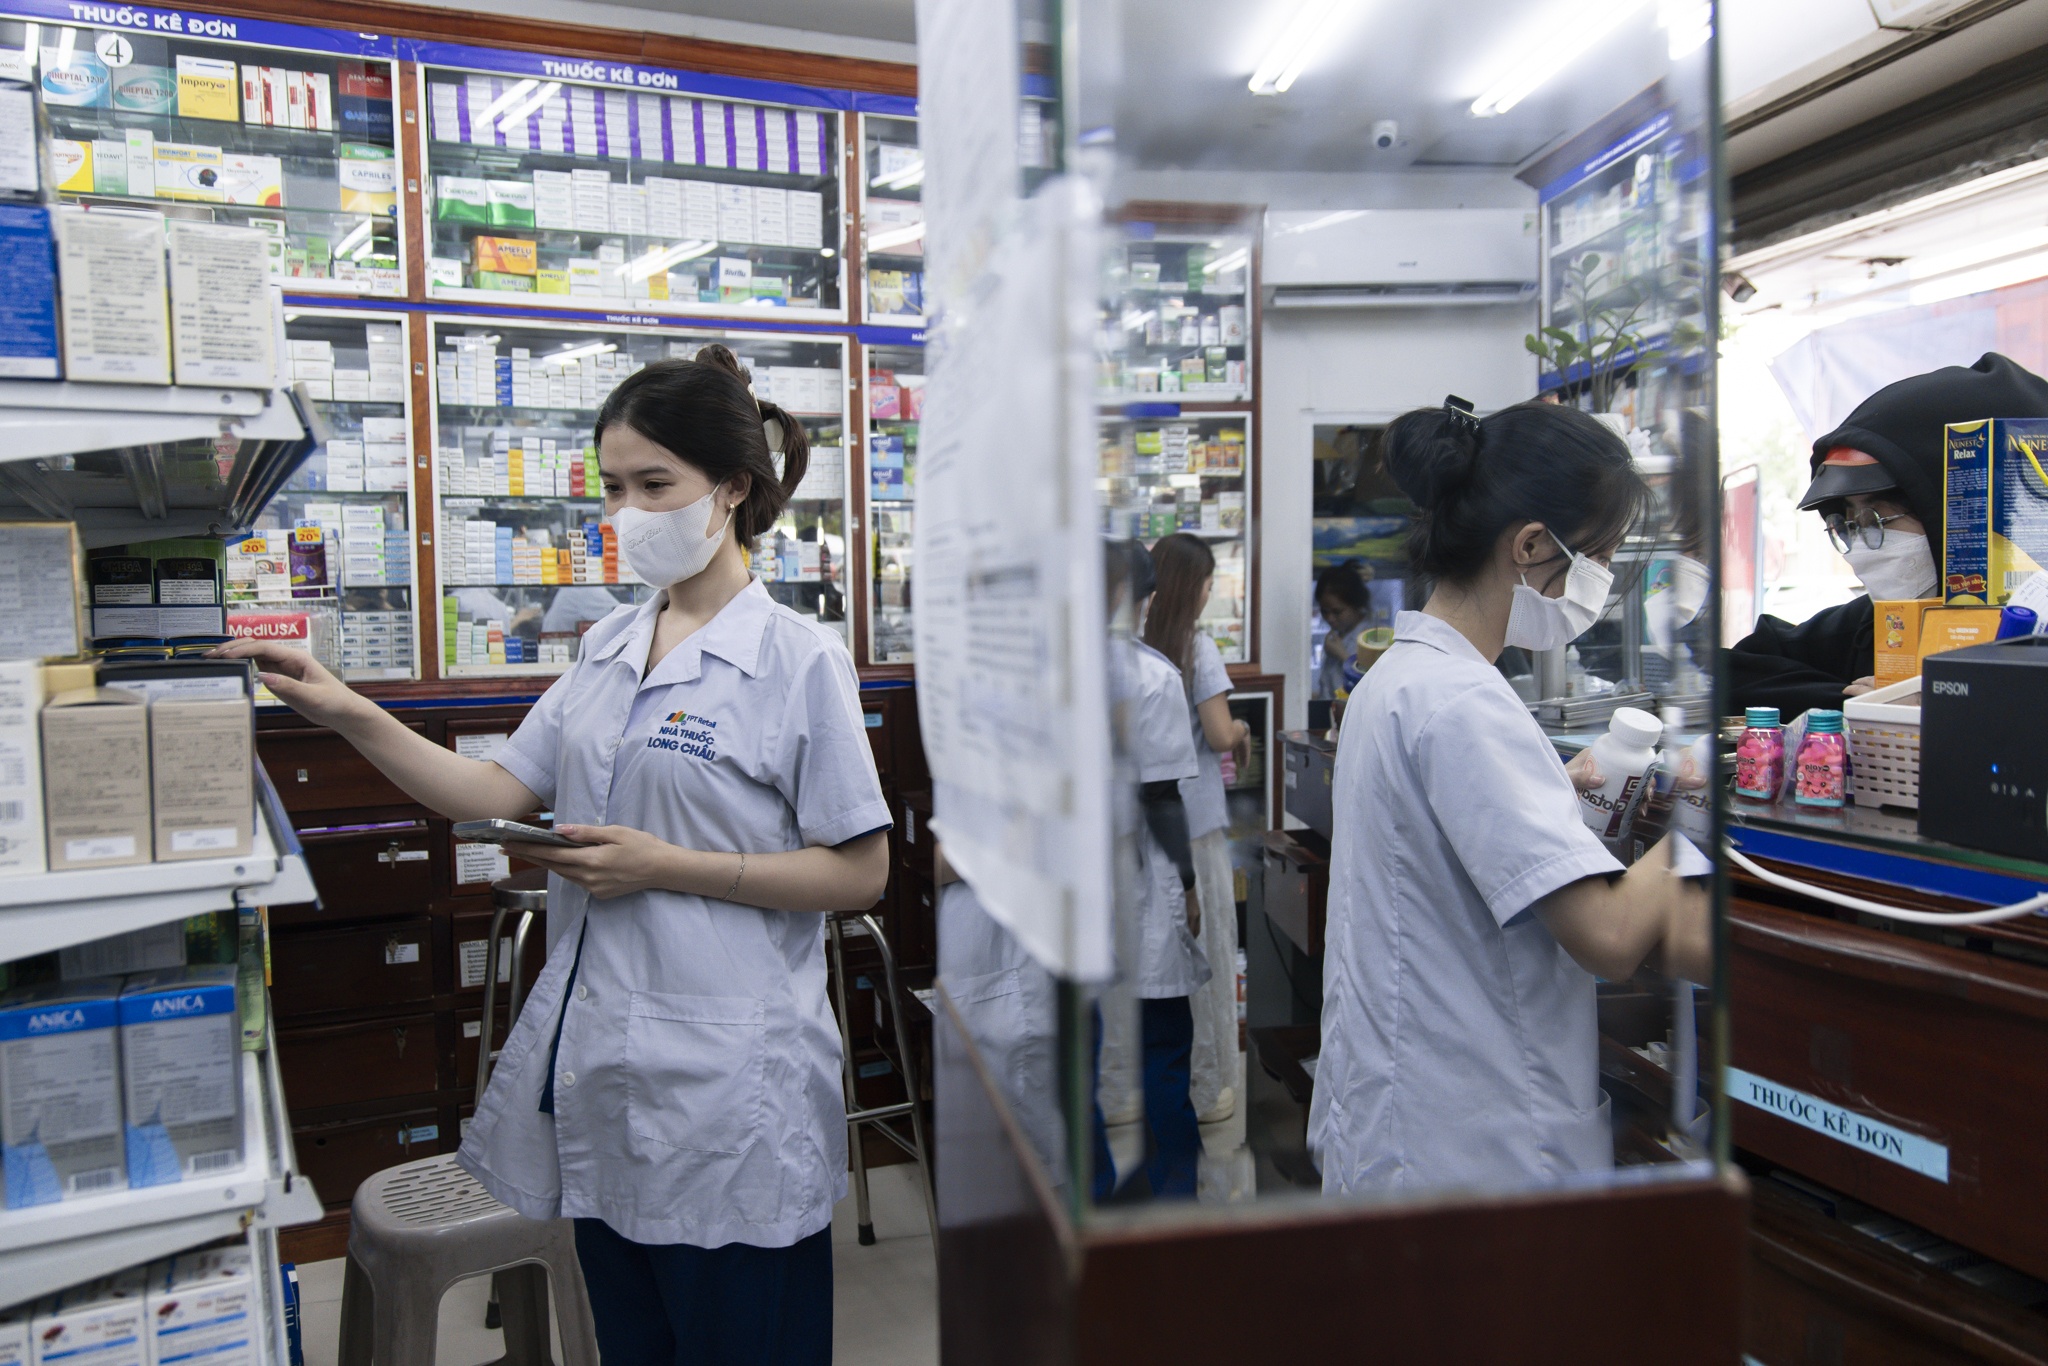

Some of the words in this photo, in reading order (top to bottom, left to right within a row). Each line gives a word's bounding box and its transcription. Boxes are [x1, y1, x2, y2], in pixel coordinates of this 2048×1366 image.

[68, 3, 149, 28] THUỐC
[154, 13, 183, 32] KÊ
[188, 18, 237, 39] ĐƠN
[105, 38, 124, 64] 4
[542, 60, 606, 81] THUỐC
[610, 66, 634, 84] KÊ
[637, 71, 678, 89] ĐƠN
[498, 245, 532, 255] AMEFLU
[501, 278, 533, 288] AMEFLU
[1954, 449, 1976, 460] Relax
[229, 623, 299, 638] MediUSA
[1933, 681, 1969, 696] EPSON
[686, 715, 698, 723] FPT
[698, 717, 717, 729] Retail
[659, 725, 678, 736] NHÀ
[680, 729, 715, 745] THUỐC
[647, 737, 679, 751] LONG
[680, 742, 716, 761] CHÂU
[151, 994, 205, 1014] ANICA
[28, 1008, 85, 1030] ANICA
[1750, 1082, 1817, 1123] THUỐC
[1823, 1110, 1850, 1137] KÊ
[1856, 1123, 1903, 1157] ĐƠN
